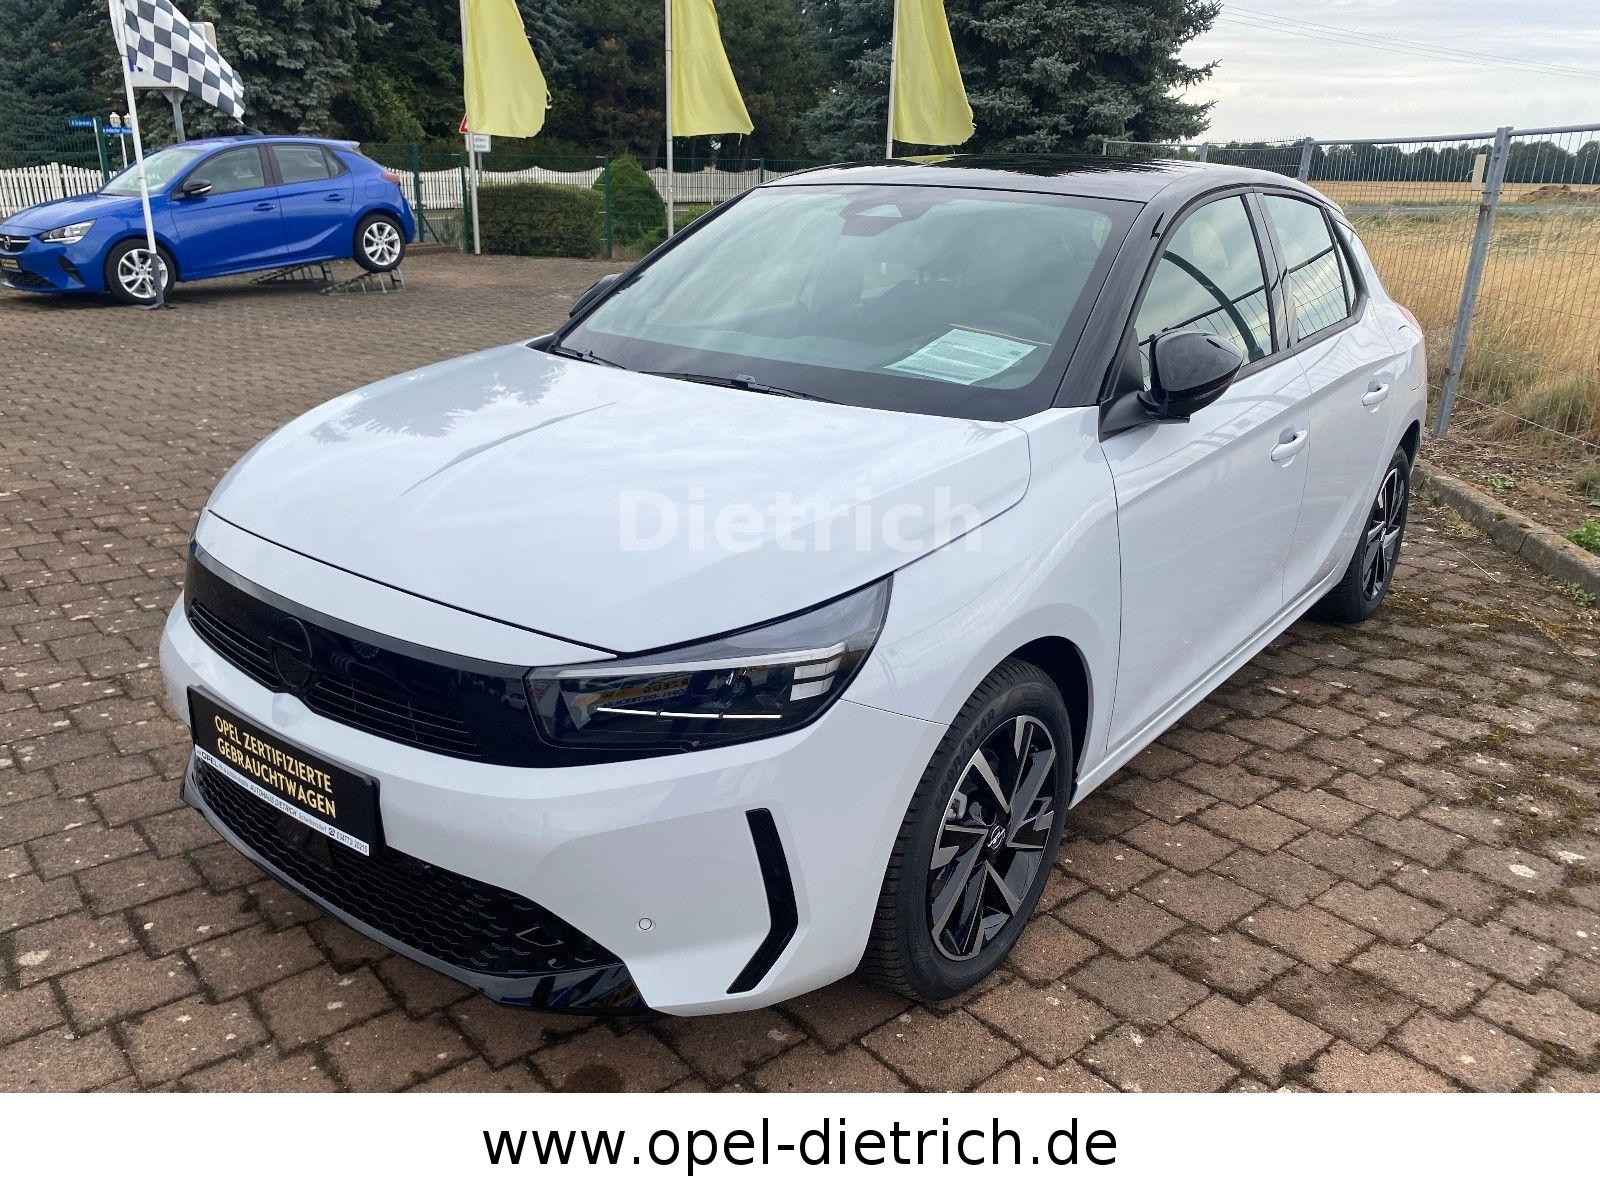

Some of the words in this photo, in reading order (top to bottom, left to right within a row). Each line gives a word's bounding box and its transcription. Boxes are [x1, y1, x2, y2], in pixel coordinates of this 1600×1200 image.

[214, 715, 242, 745] OPEL
[243, 732, 333, 793] ZERTIFIZIERTE
[217, 737, 336, 818] GEBRAUCHTWAGEN
